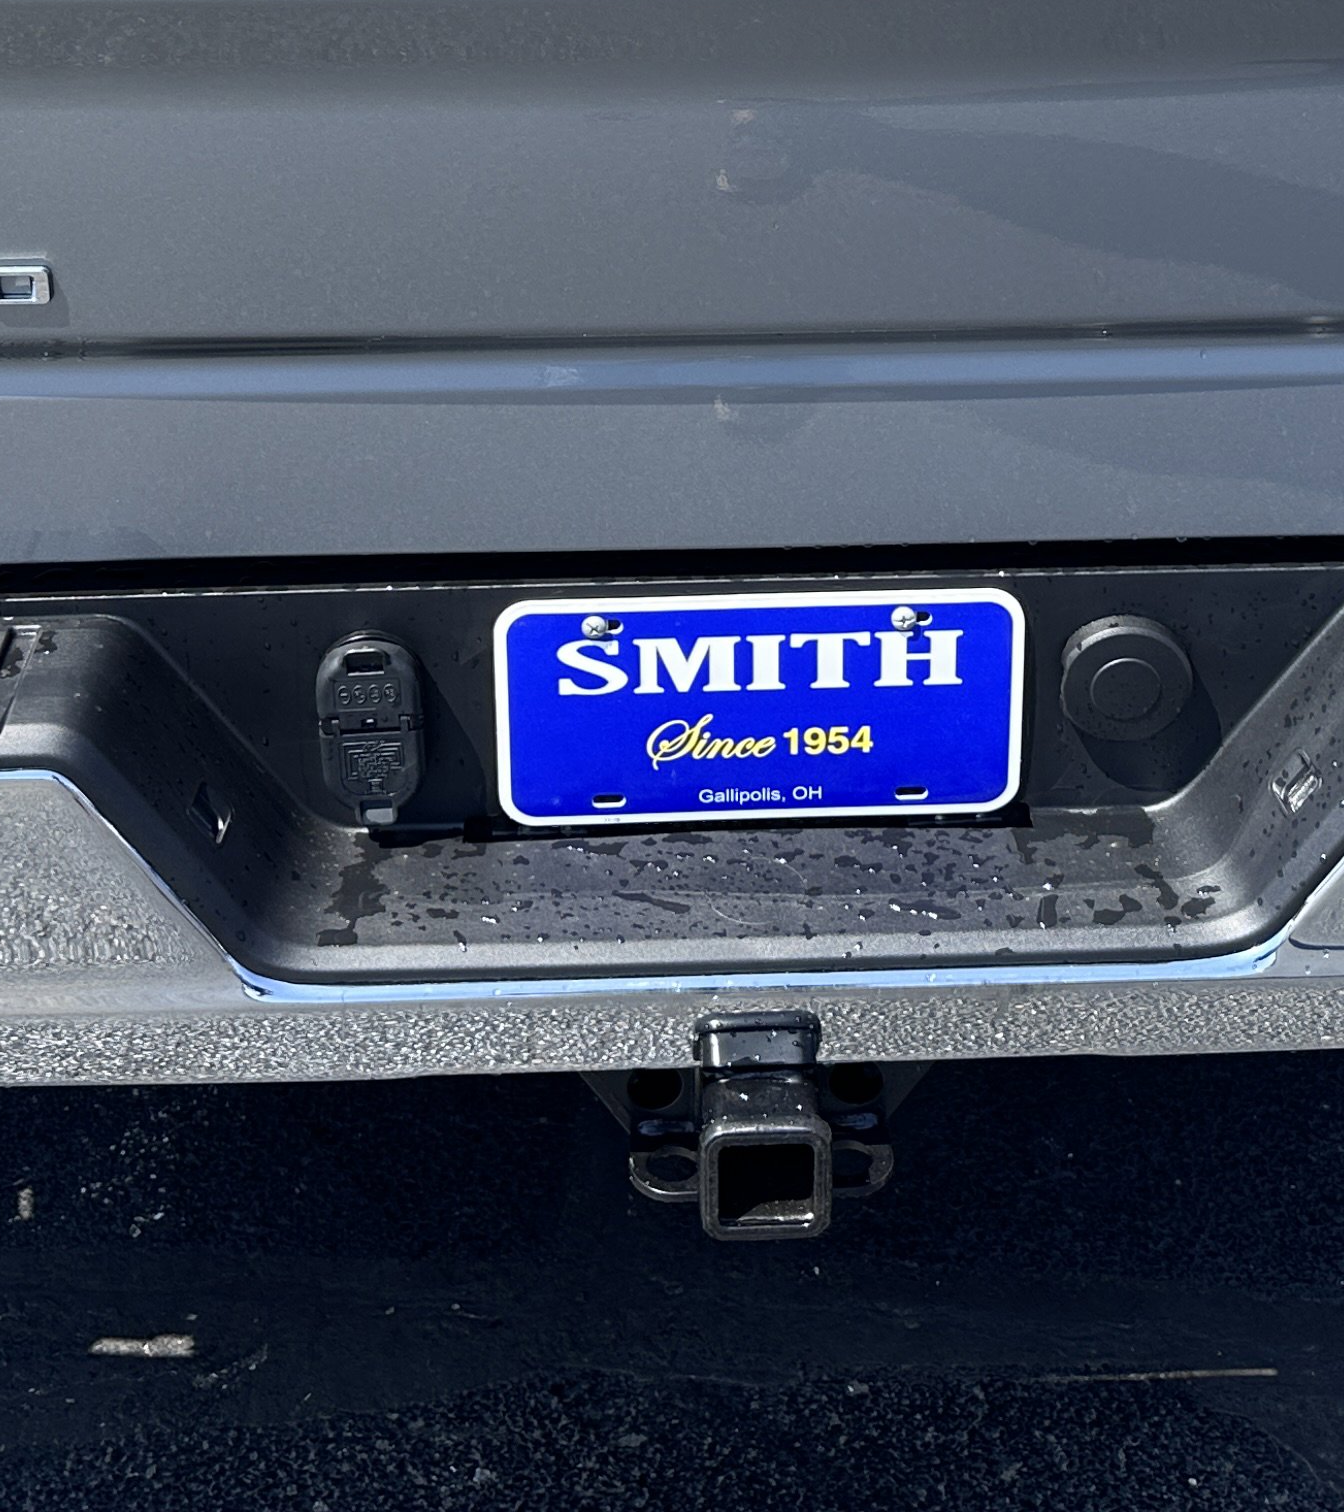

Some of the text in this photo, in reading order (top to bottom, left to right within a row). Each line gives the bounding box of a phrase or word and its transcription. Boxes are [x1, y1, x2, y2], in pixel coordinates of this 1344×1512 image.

[556, 629, 964, 696] SMITH
[645, 713, 874, 771] Since 1954
[698, 785, 823, 805] Gallipolis, OH
